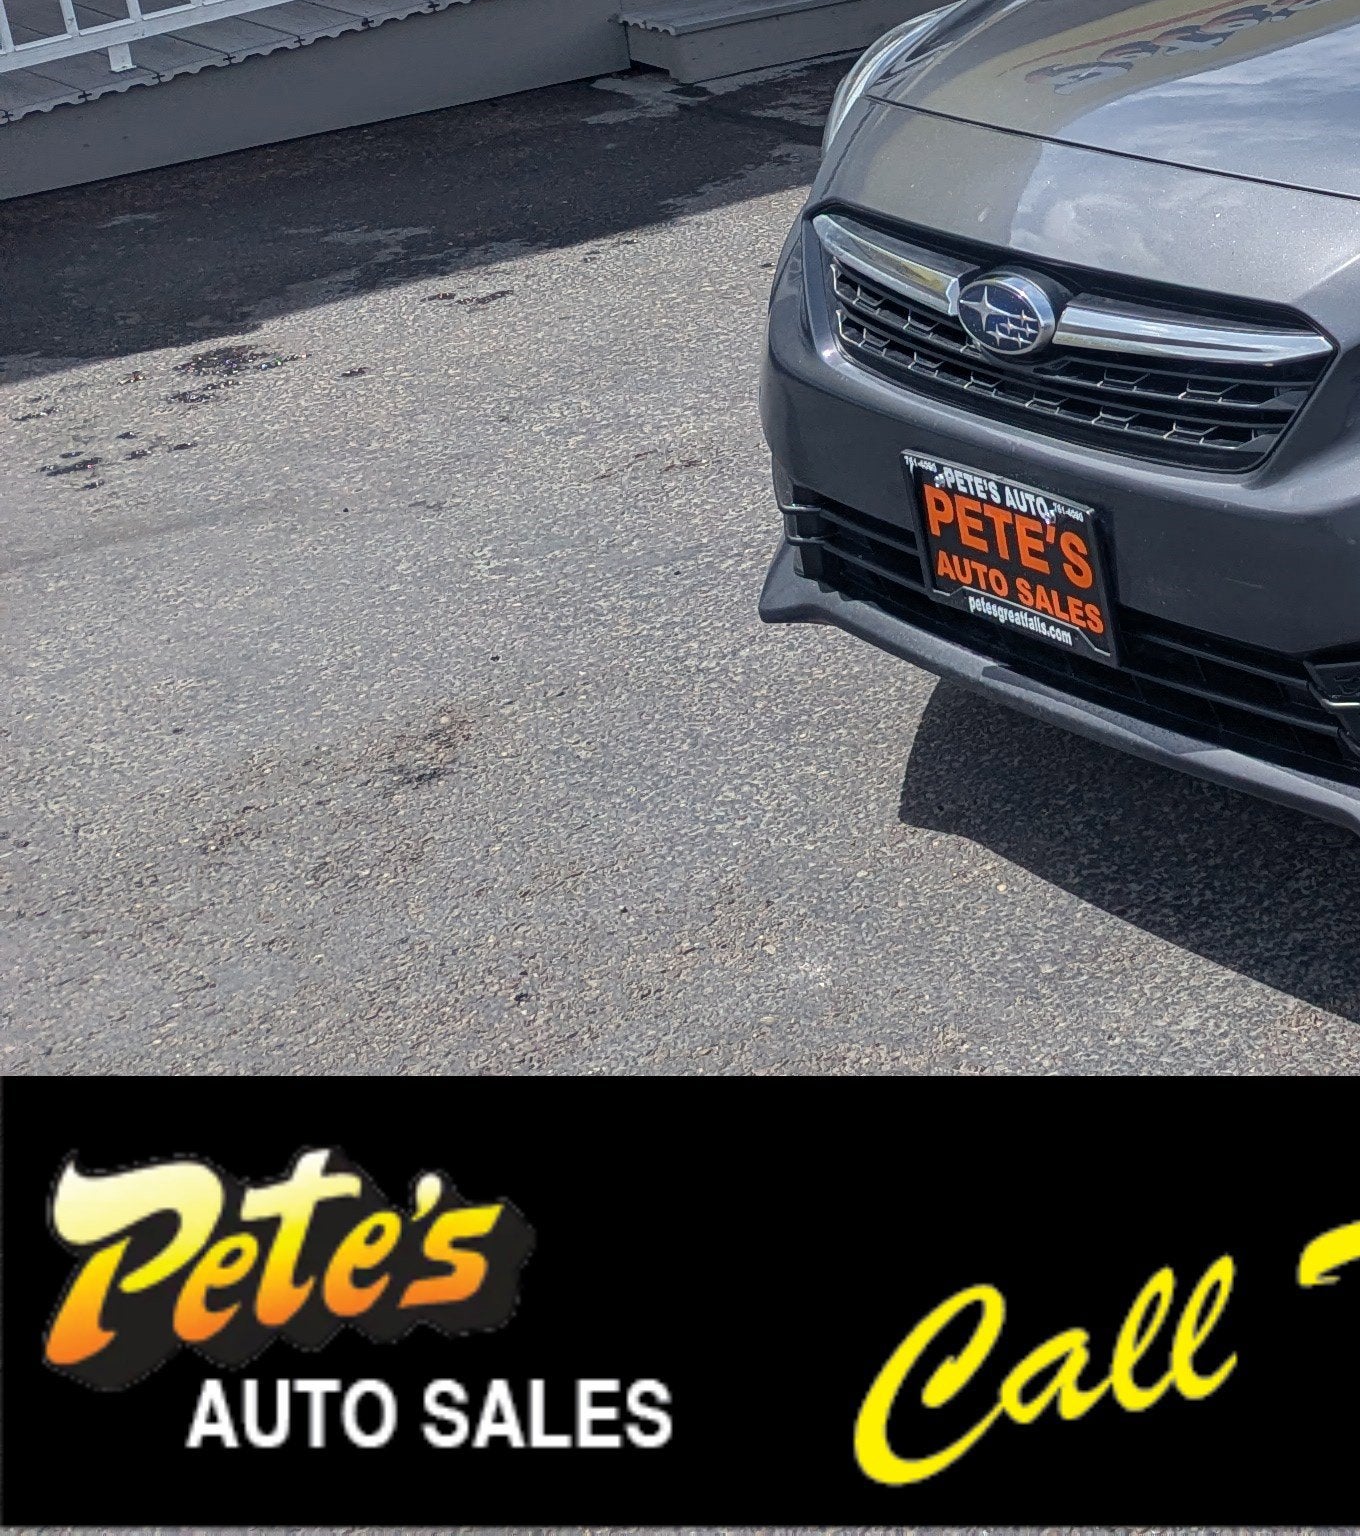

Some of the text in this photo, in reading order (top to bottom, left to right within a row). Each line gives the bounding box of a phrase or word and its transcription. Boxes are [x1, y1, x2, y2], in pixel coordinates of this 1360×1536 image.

[943, 466, 1049, 518] PETE'S AUTO
[923, 483, 1093, 589] PETE'S
[937, 549, 1105, 635] AUTO SALES
[968, 595, 1073, 646] petesgreatfalls.com
